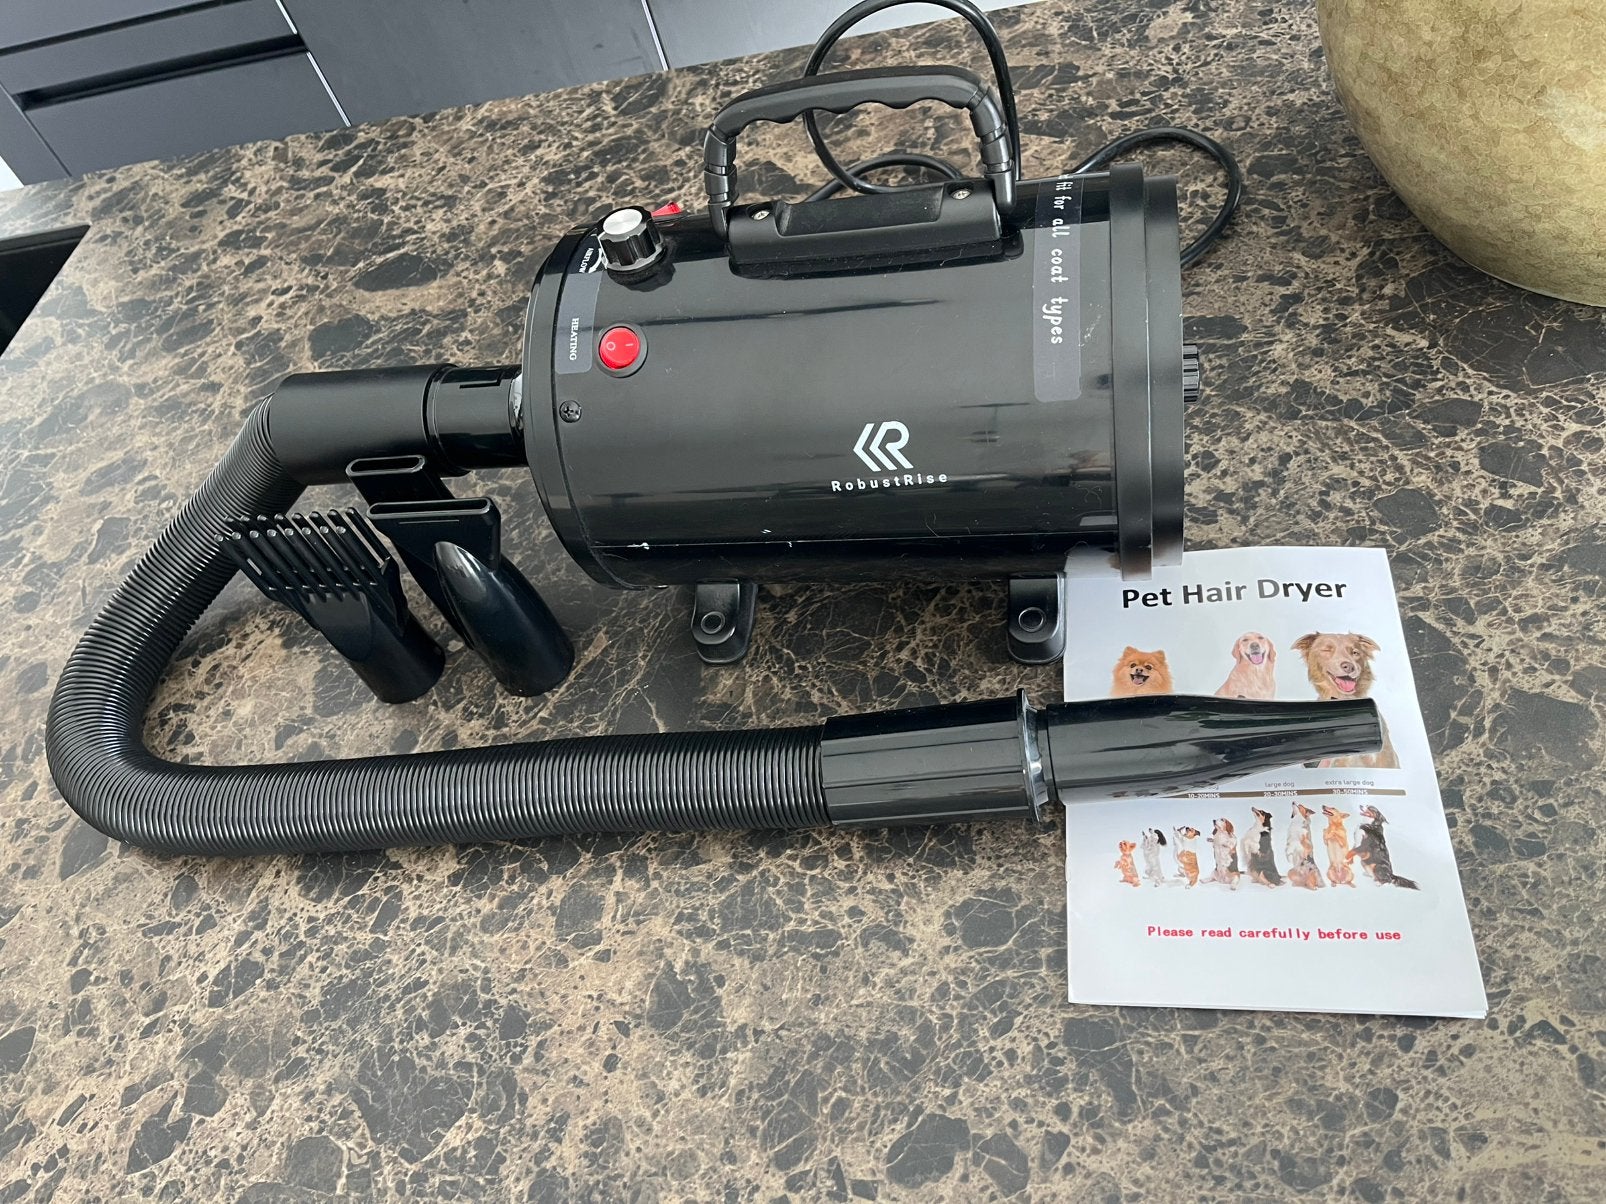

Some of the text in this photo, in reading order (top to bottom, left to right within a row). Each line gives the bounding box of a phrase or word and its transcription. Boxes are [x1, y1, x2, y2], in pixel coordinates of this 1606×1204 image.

[1053, 195, 1072, 210] for
[1051, 218, 1070, 238] all
[1050, 248, 1069, 283] coat
[1041, 296, 1069, 345] types
[569, 317, 580, 361] HEATING
[830, 473, 948, 492] RobustRise
[1122, 578, 1347, 608] Pet Hair Dryer
[1147, 926, 1401, 940] Please read carefully before use
